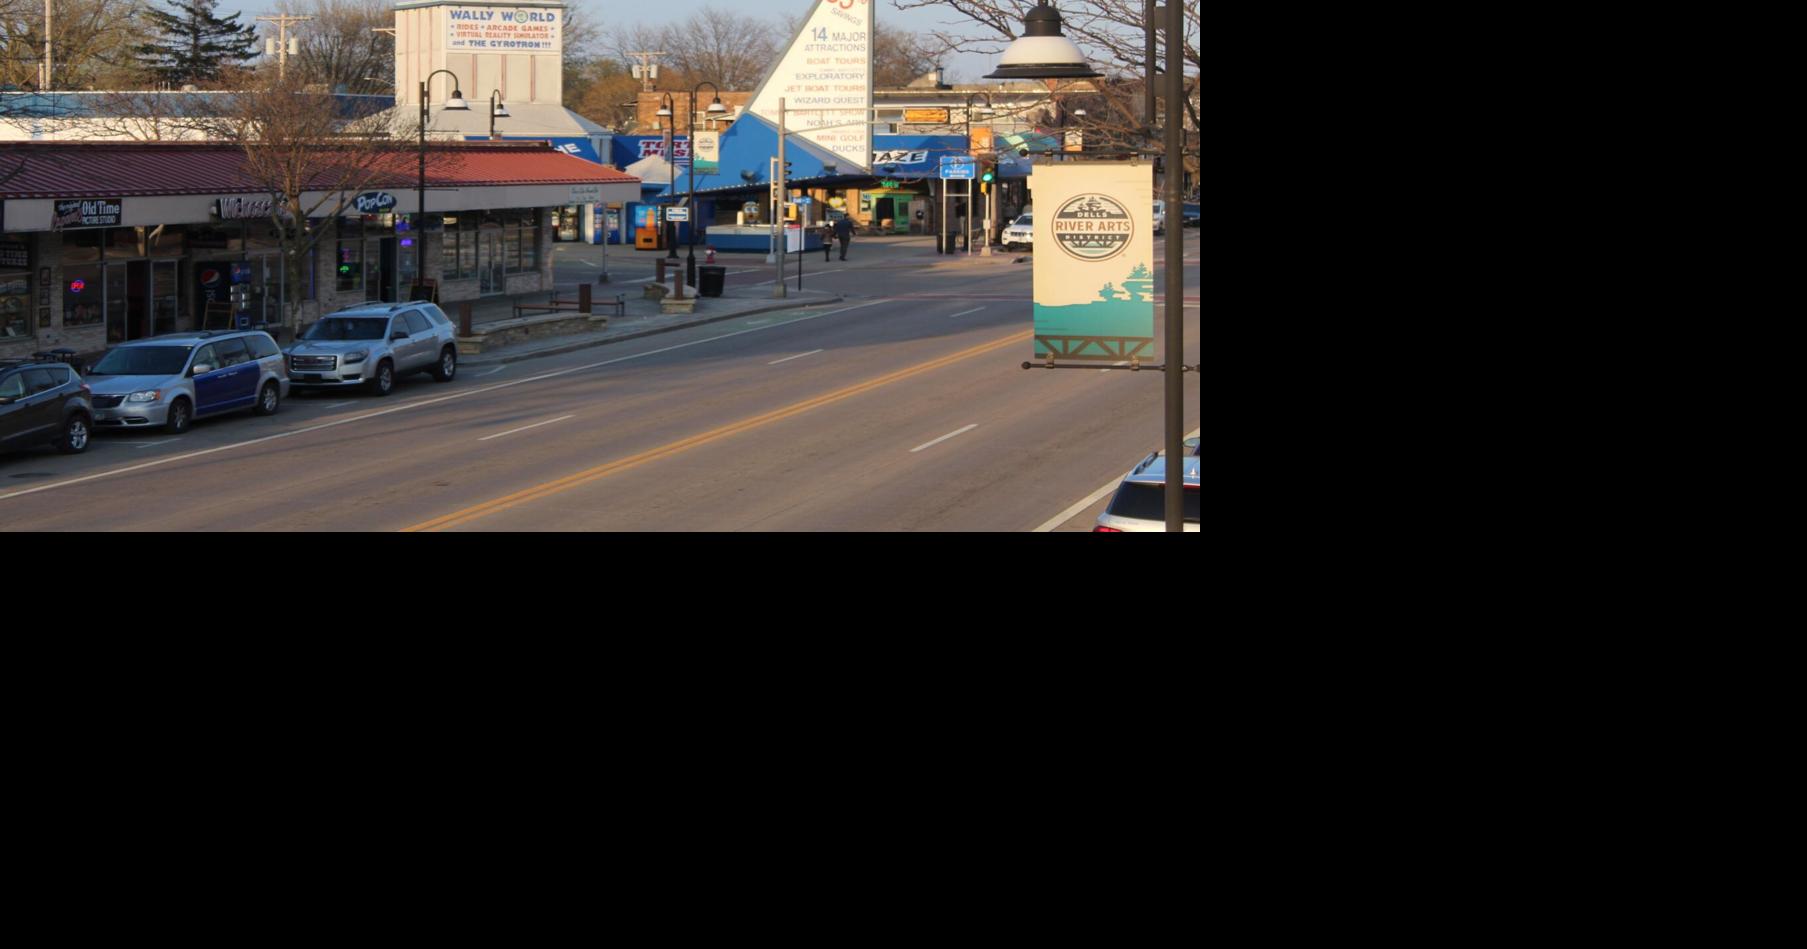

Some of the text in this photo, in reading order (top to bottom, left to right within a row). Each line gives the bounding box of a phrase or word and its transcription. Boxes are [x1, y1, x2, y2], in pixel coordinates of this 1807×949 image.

[450, 10, 494, 21] WALLY
[811, 27, 866, 42] 14 MAJOR
[804, 43, 866, 52] ATTRACTIONS
[806, 57, 866, 65] BOAT TOURS
[795, 73, 865, 81] EXPLORATORY
[784, 85, 801, 93] JET
[816, 134, 865, 142] MINI GOLF
[832, 145, 865, 153] DUCKS
[82, 200, 97, 215] Old
[97, 200, 120, 215] Time
[1055, 221, 1131, 232] RIVER ARTS
